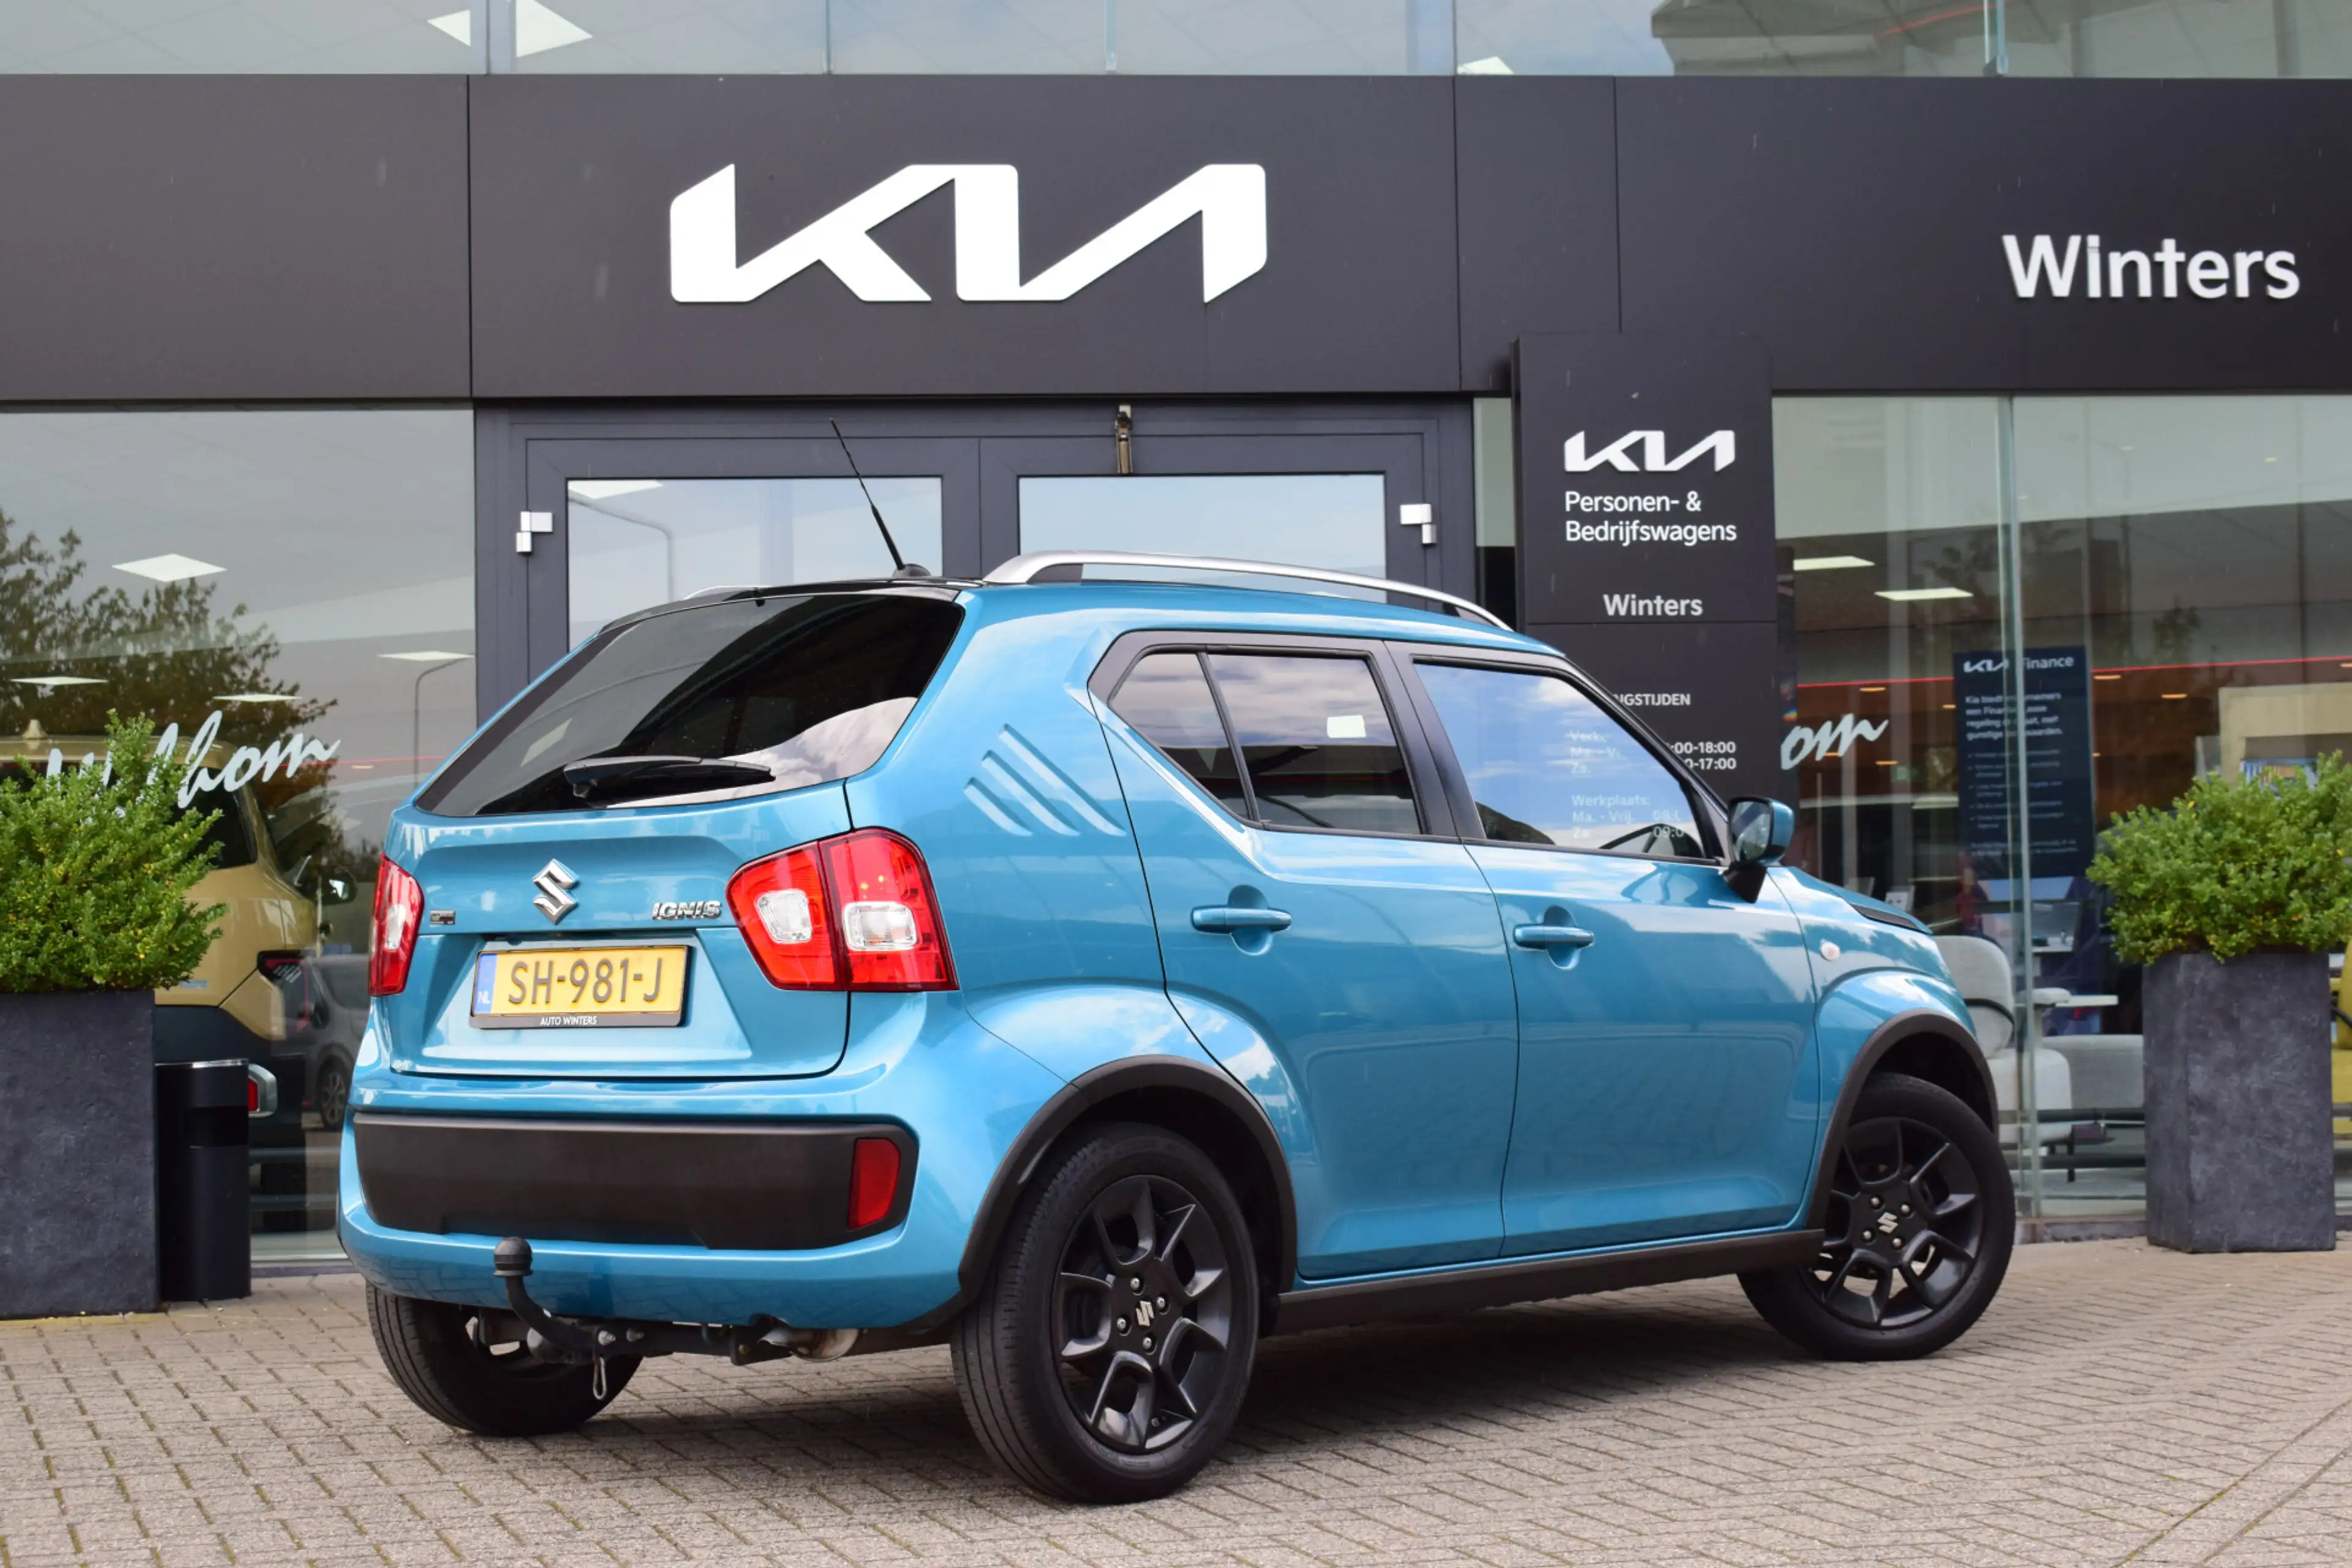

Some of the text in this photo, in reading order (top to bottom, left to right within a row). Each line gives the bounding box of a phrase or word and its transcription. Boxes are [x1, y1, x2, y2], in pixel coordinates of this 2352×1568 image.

[2002, 235, 2300, 298] Winters
[1565, 491, 1702, 511] Personen- &
[1566, 520, 1737, 546] Bedrijfswagens
[1603, 594, 1703, 616] Winters
[1571, 794, 1651, 808] Werkplaats:
[652, 900, 722, 919] IGNIS
[478, 957, 663, 1005] NL SH-981-J
[540, 1015, 597, 1026] AUTO WINTERS
